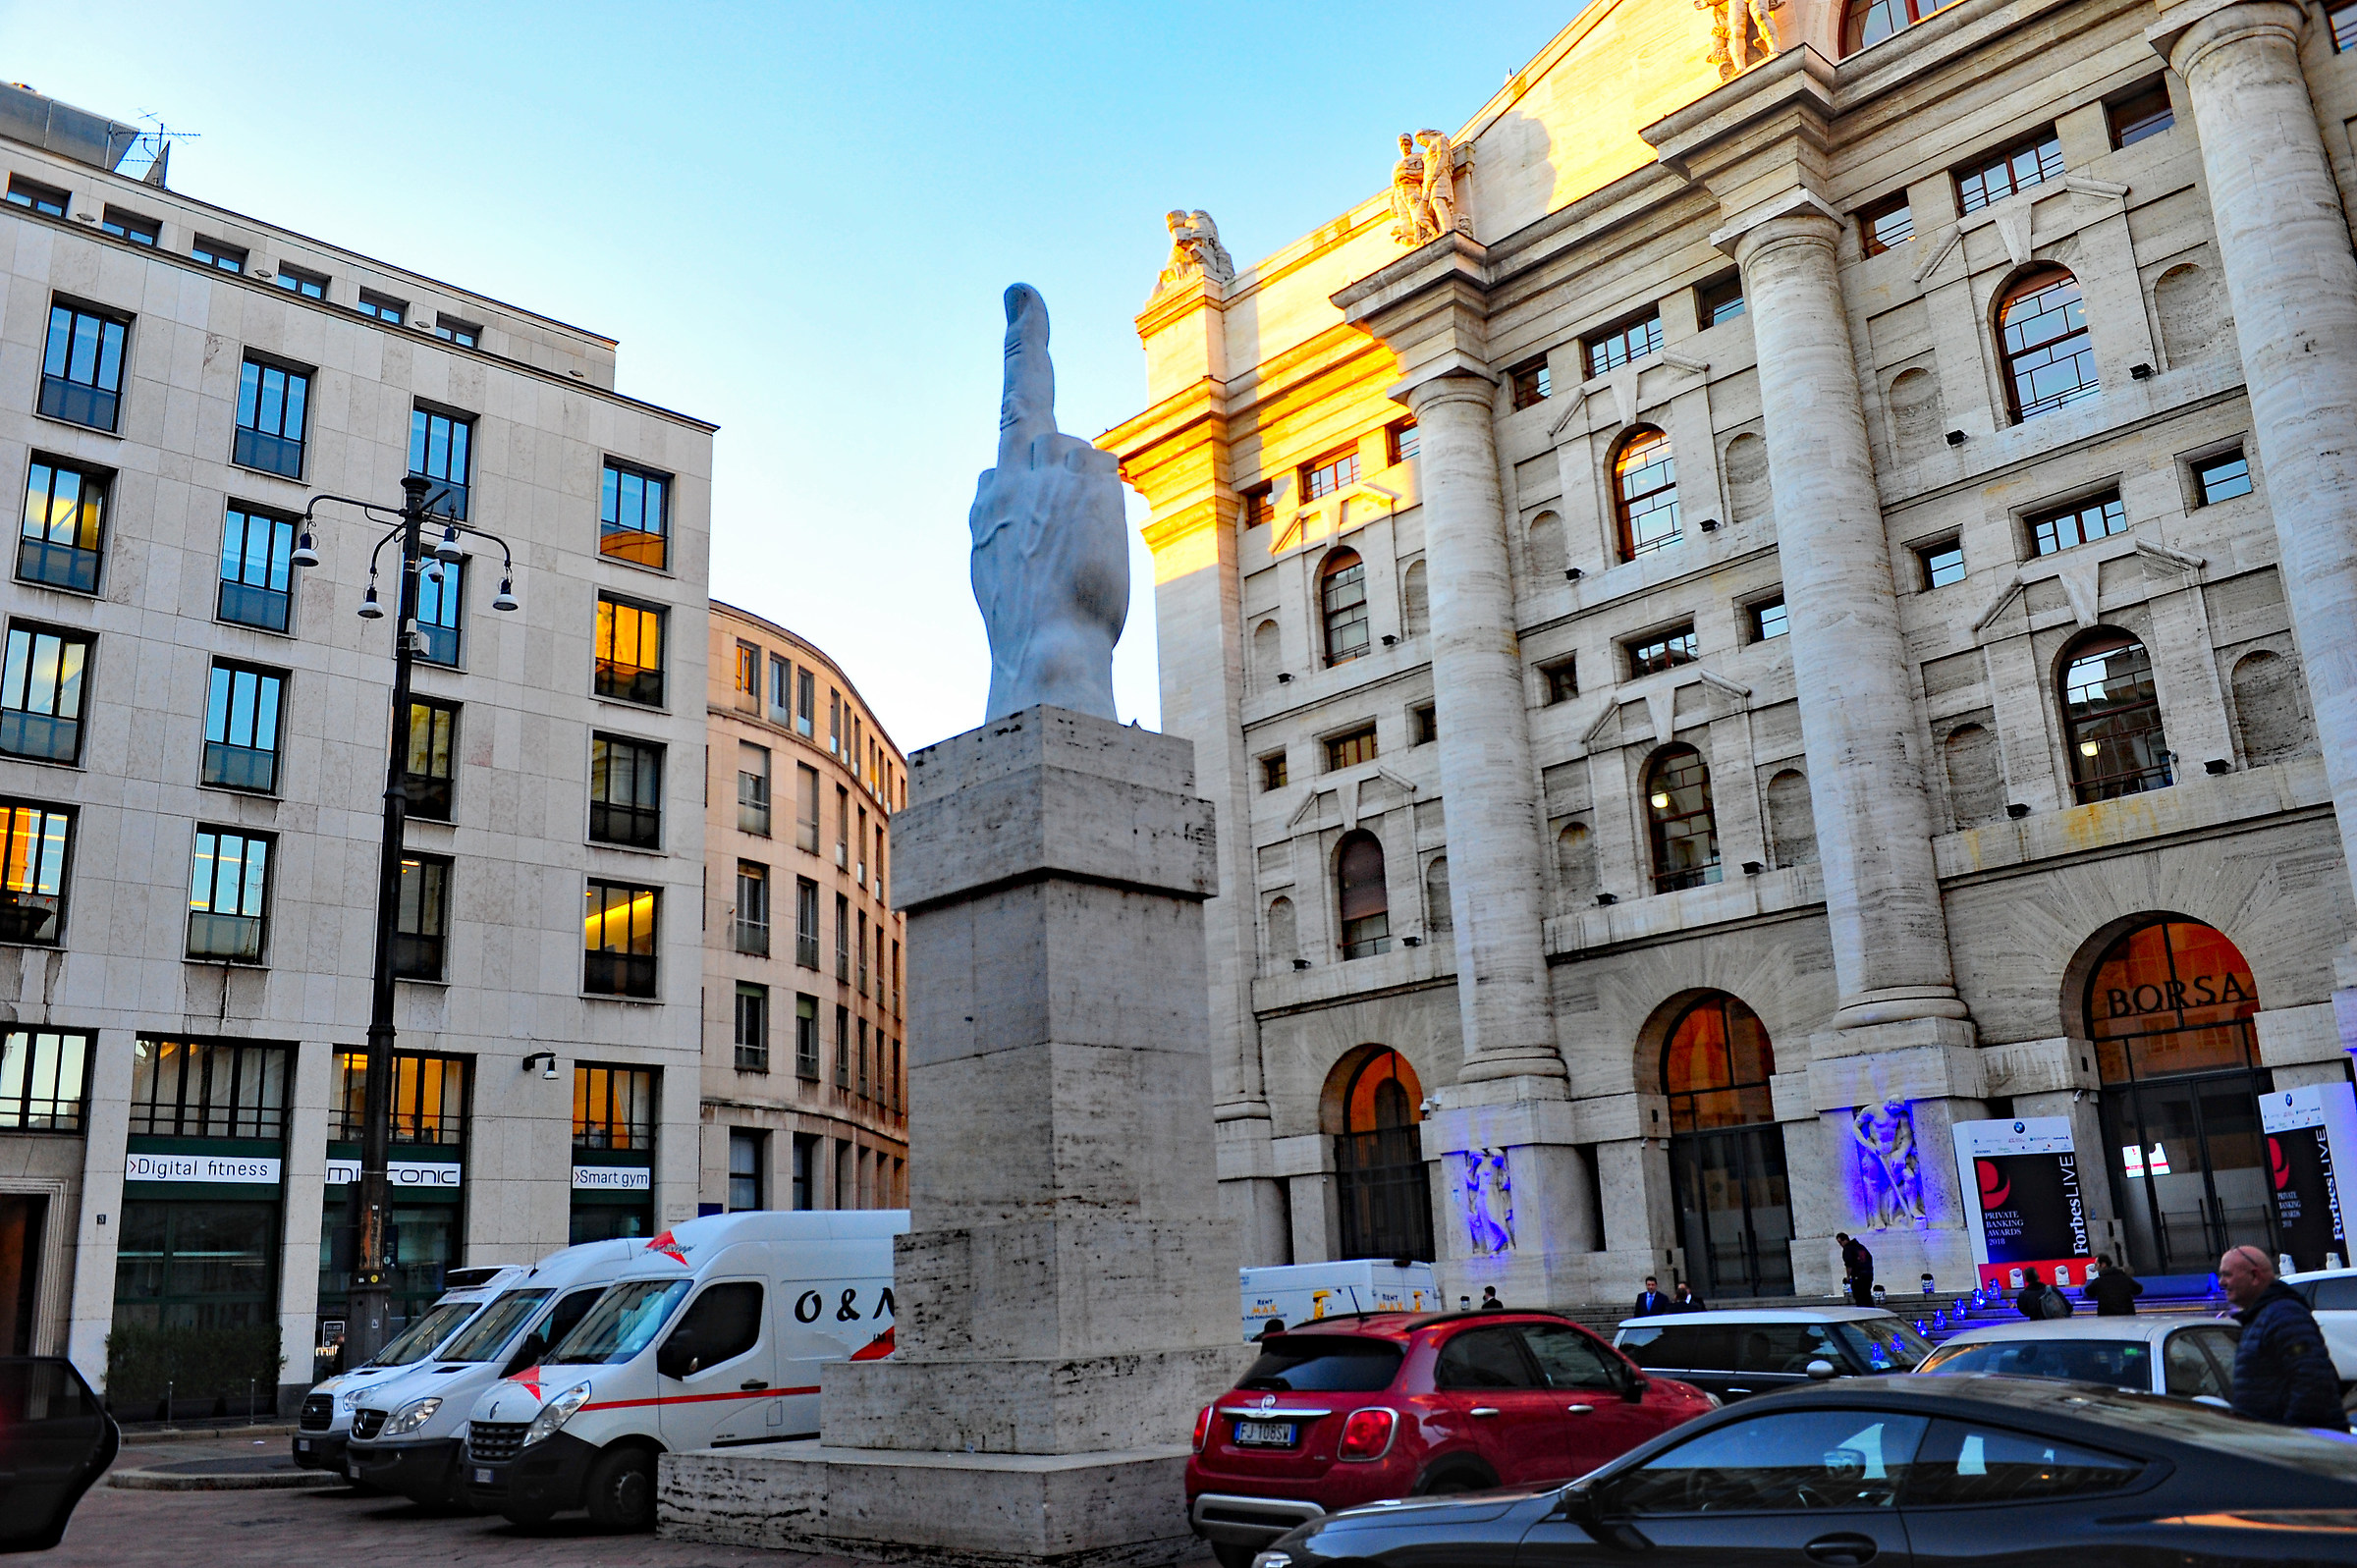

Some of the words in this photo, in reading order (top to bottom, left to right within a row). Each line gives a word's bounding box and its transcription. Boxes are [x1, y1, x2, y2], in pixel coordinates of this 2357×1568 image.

[2107, 971, 2258, 1018] BORSA
[137, 1159, 197, 1179] Digital
[208, 1161, 269, 1176] fitness
[579, 1169, 618, 1184] Smart
[622, 1173, 648, 1188] gym
[1985, 1211, 2019, 1219] PRIVATE
[1986, 1219, 2024, 1228] BANKING
[1988, 1228, 2022, 1237] AWARDS
[836, 1288, 861, 1322] &
[1251, 1305, 1277, 1314] MAX
[1240, 1424, 1253, 1439] FJ
